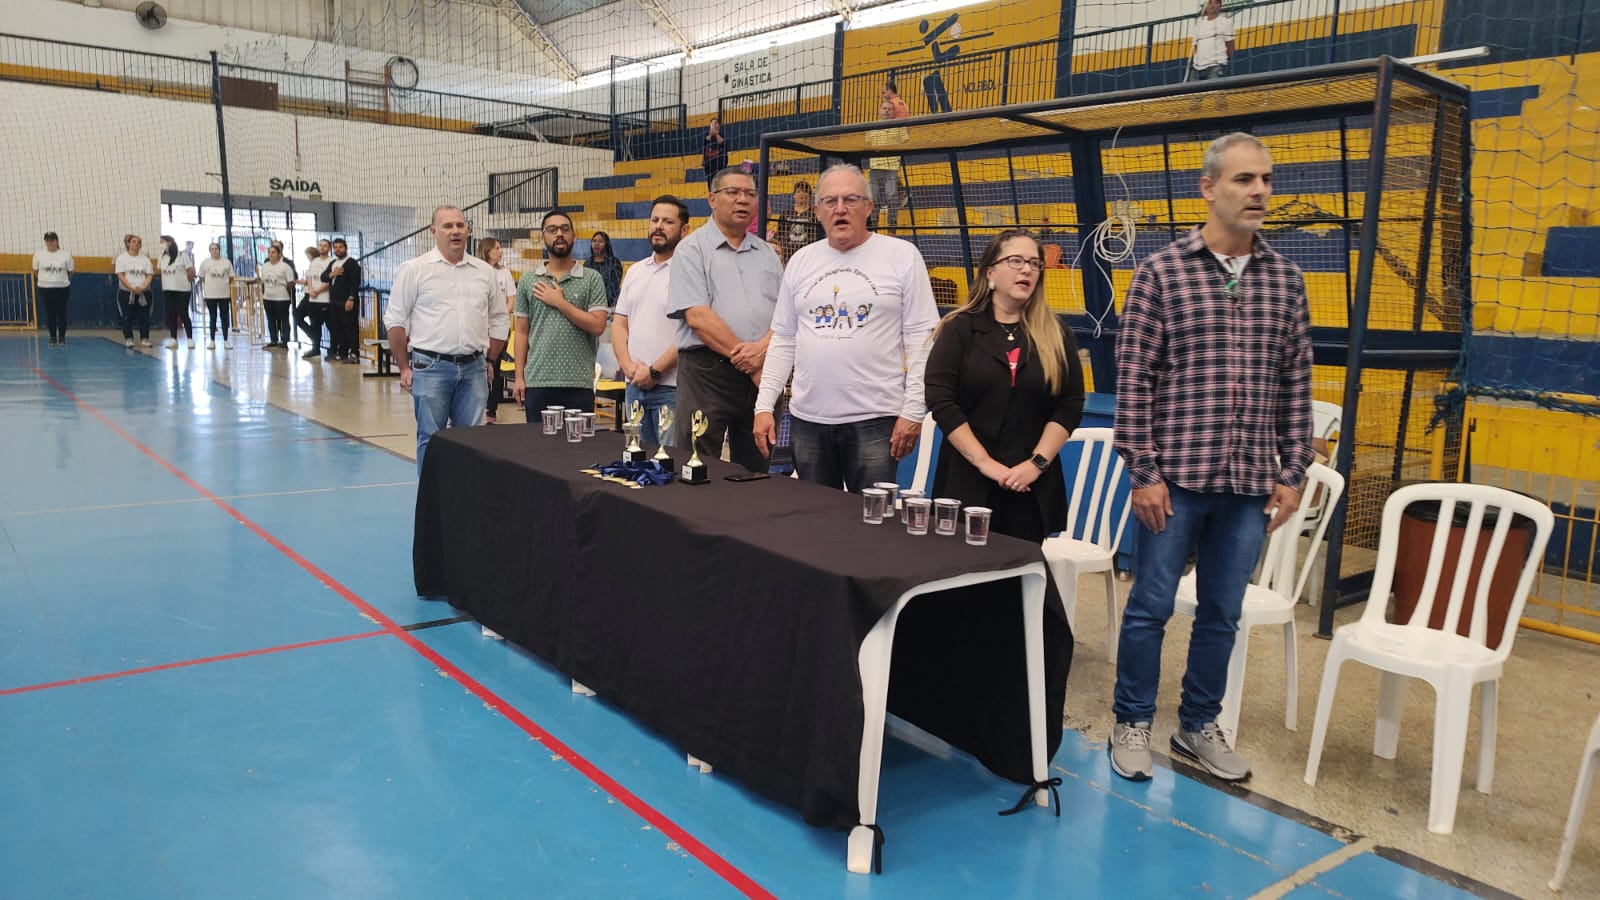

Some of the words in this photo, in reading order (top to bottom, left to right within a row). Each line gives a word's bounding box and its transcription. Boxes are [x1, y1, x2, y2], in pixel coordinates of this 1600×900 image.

[734, 60, 755, 73] SALA
[757, 56, 768, 68] DE
[270, 176, 321, 193] SAÍDA
